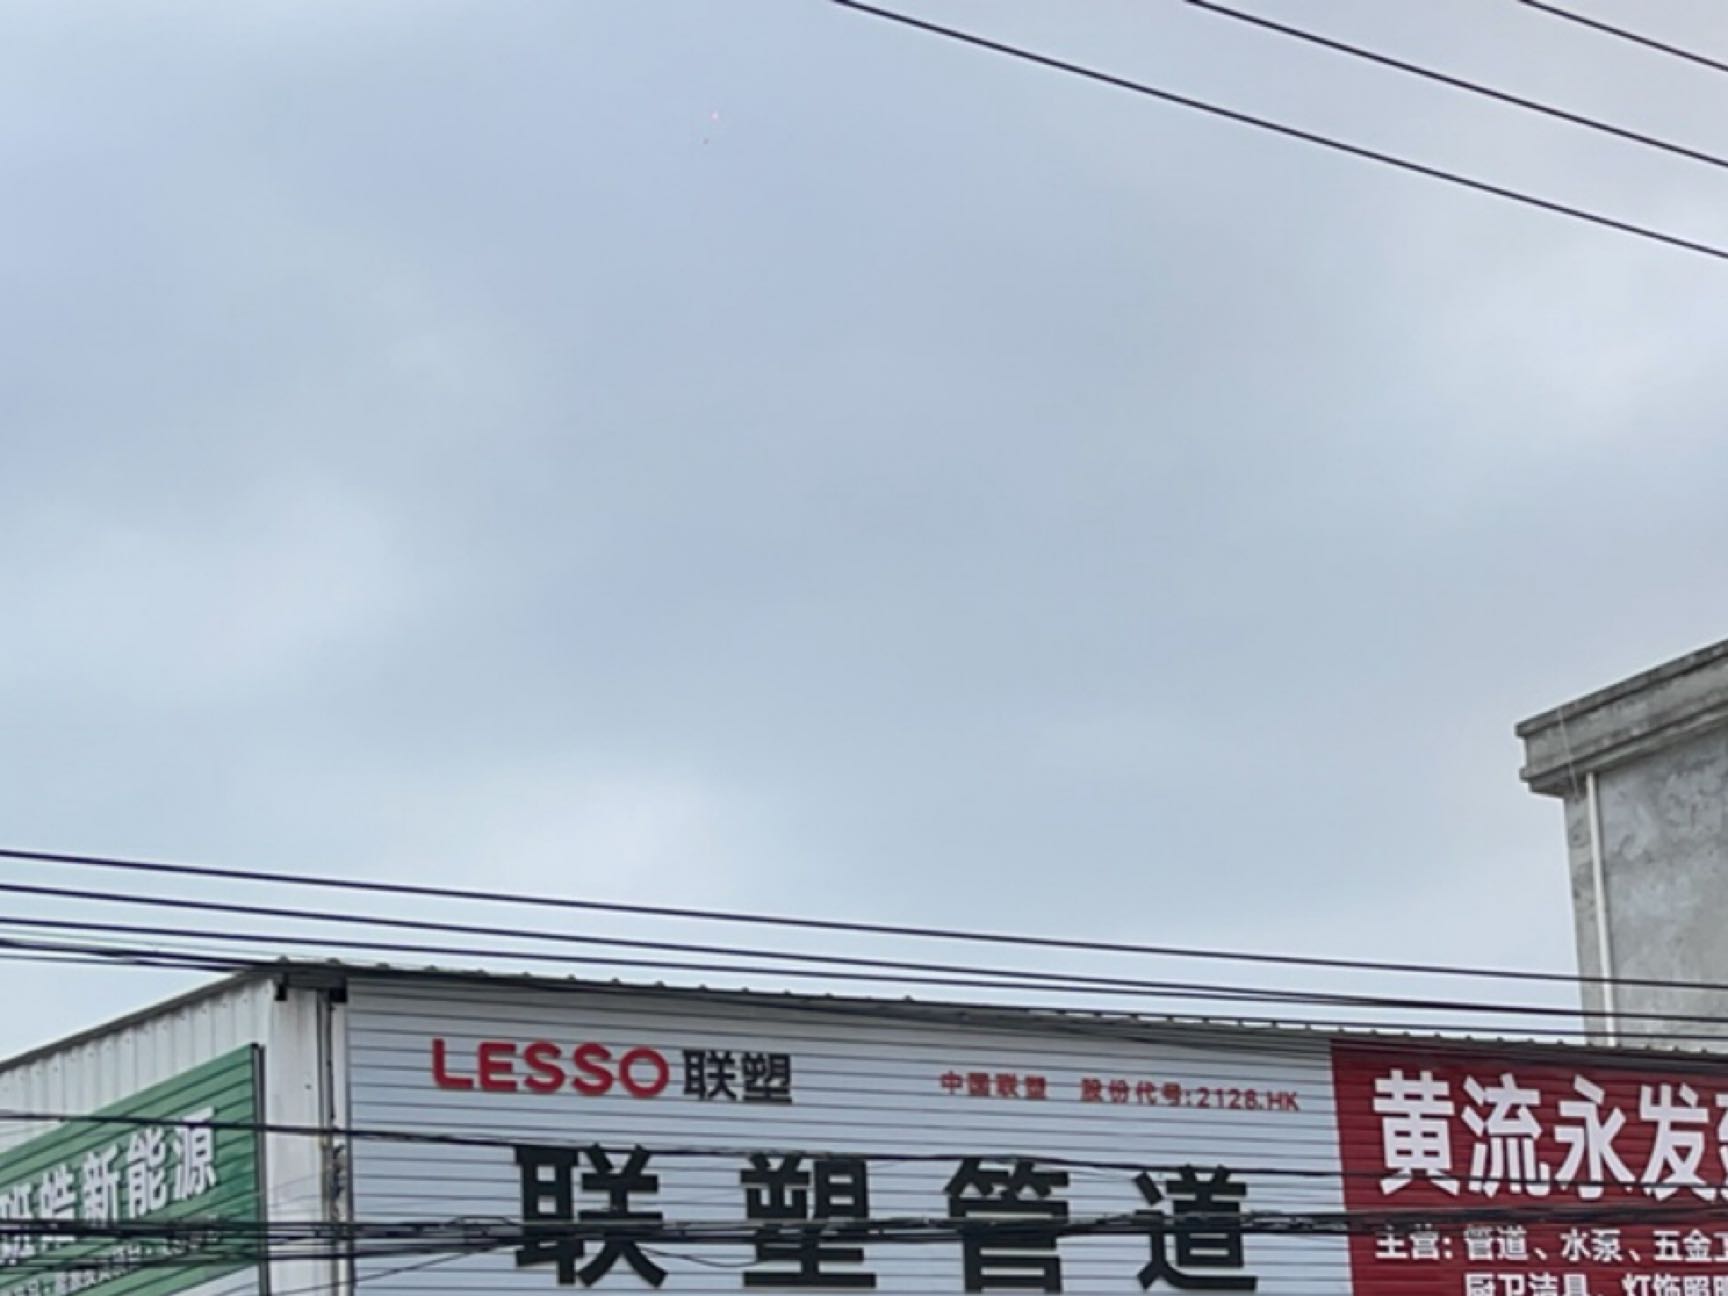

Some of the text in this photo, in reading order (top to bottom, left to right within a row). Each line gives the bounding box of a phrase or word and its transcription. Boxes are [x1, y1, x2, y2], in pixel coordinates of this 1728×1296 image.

[432, 1037, 670, 1098] LESSO
[682, 1047, 793, 1104] 联塑
[514, 1144, 1259, 1295] 联塑管道
